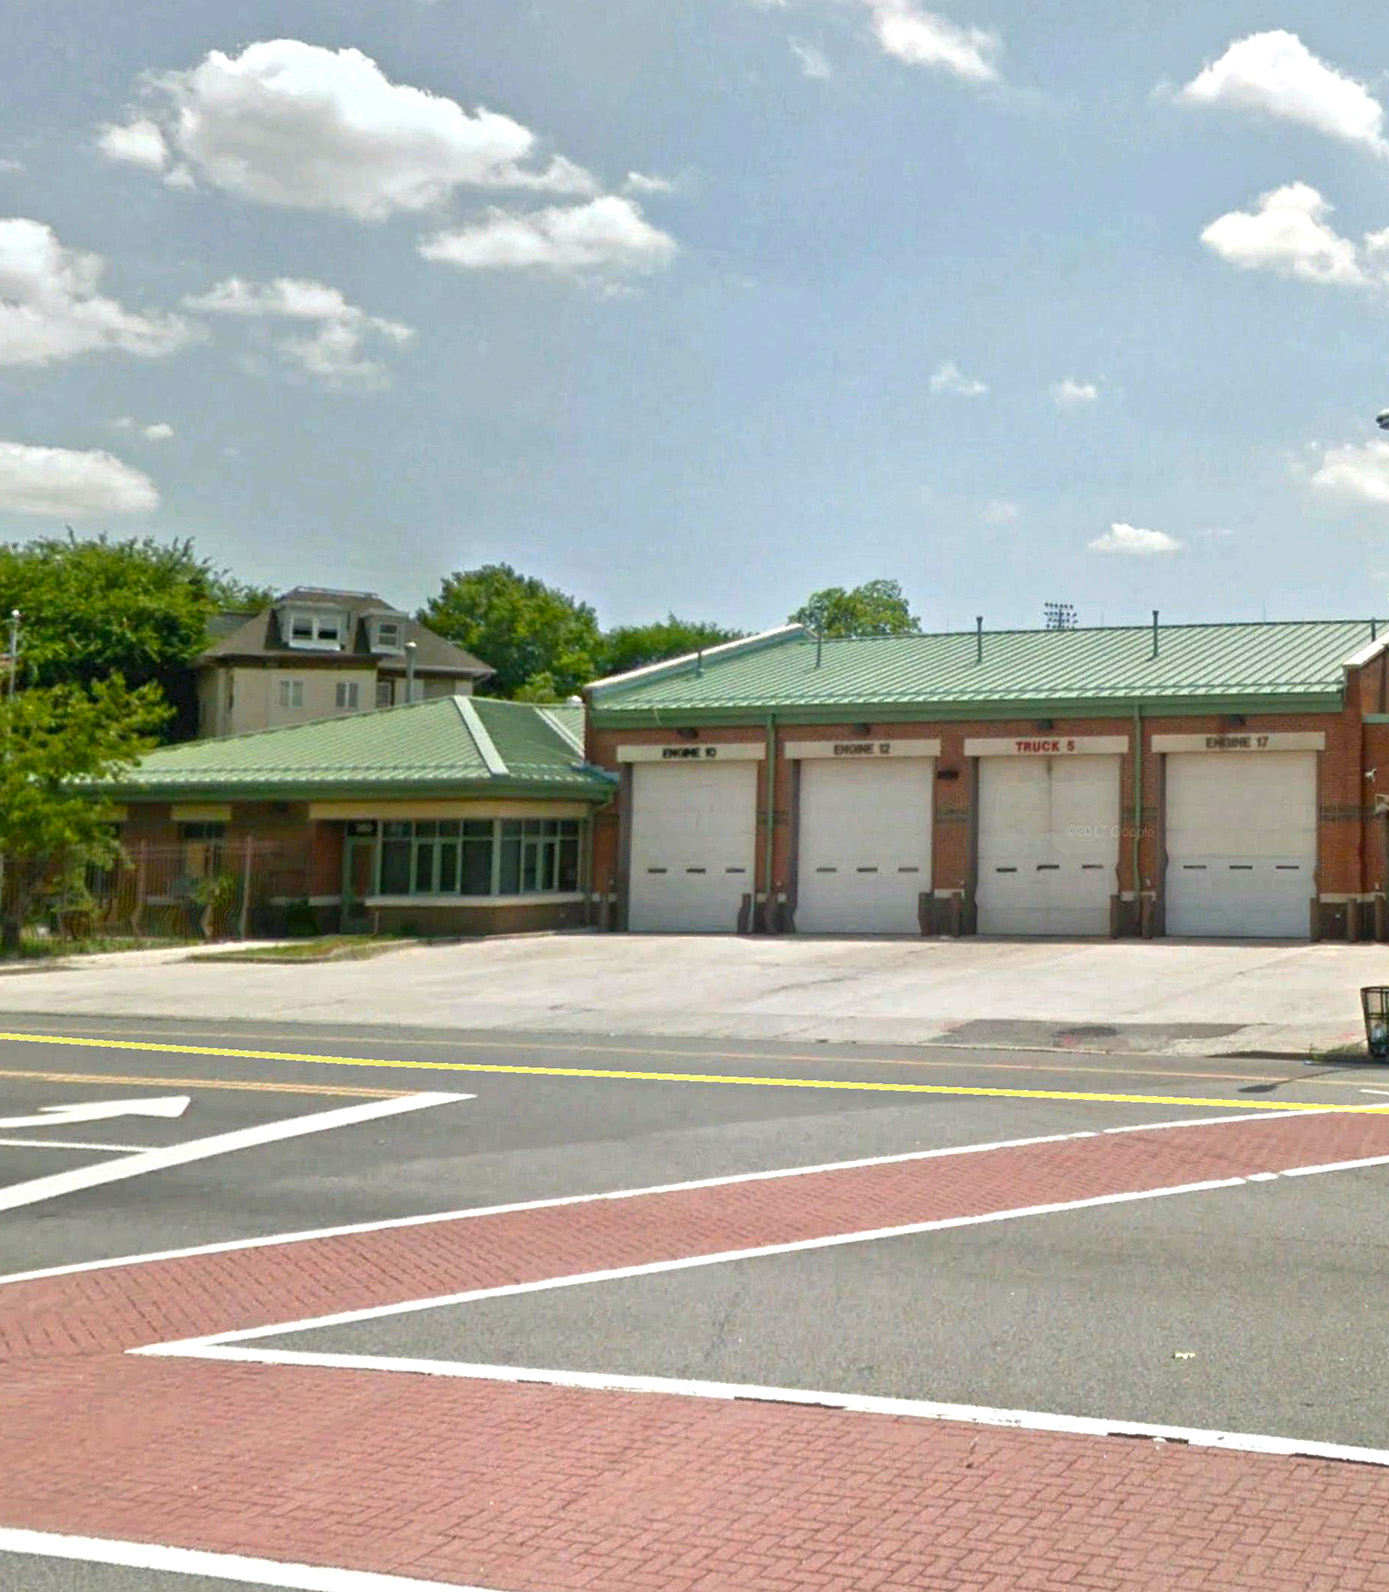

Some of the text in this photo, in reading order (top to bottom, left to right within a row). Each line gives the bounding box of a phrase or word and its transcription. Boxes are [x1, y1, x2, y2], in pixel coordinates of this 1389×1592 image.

[1015, 740, 1075, 752] TRUCK 5
[1205, 735, 1269, 749] ENGINE 17
[662, 747, 701, 759] ENGINE
[834, 743, 875, 755] ENGINE
